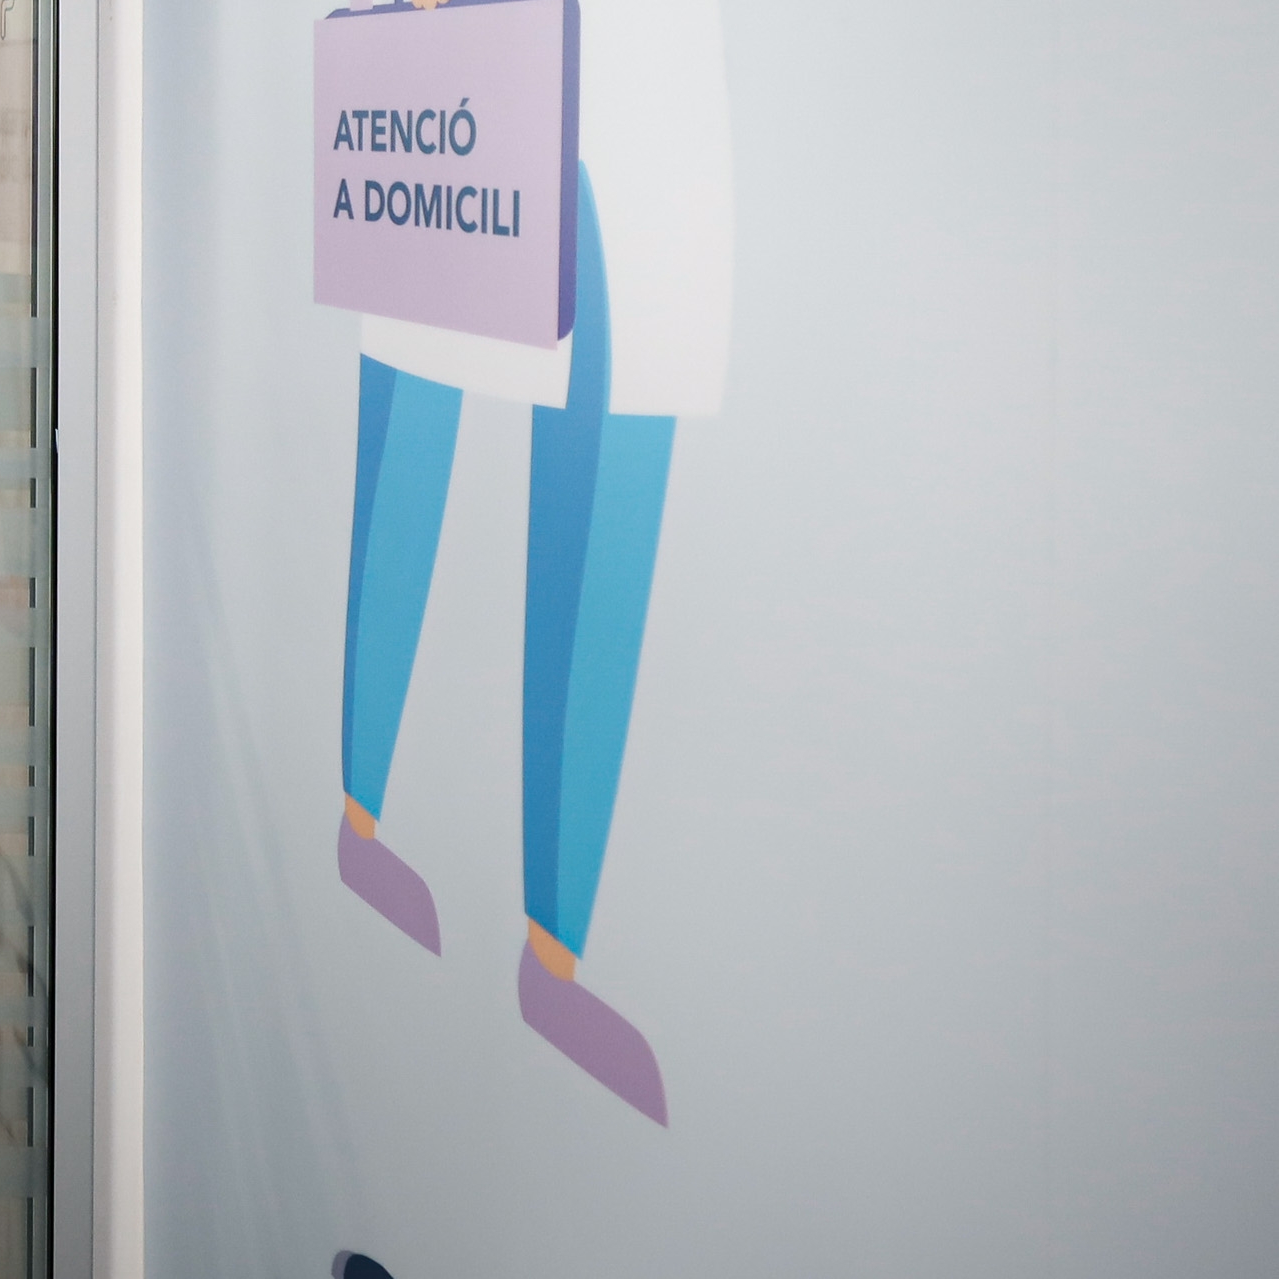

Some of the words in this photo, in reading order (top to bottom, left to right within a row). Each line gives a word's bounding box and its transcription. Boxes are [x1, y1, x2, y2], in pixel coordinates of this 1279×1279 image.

[333, 97, 477, 156] ATENCIÓ
[333, 178, 355, 220] A
[364, 180, 521, 238] DOMICILI
